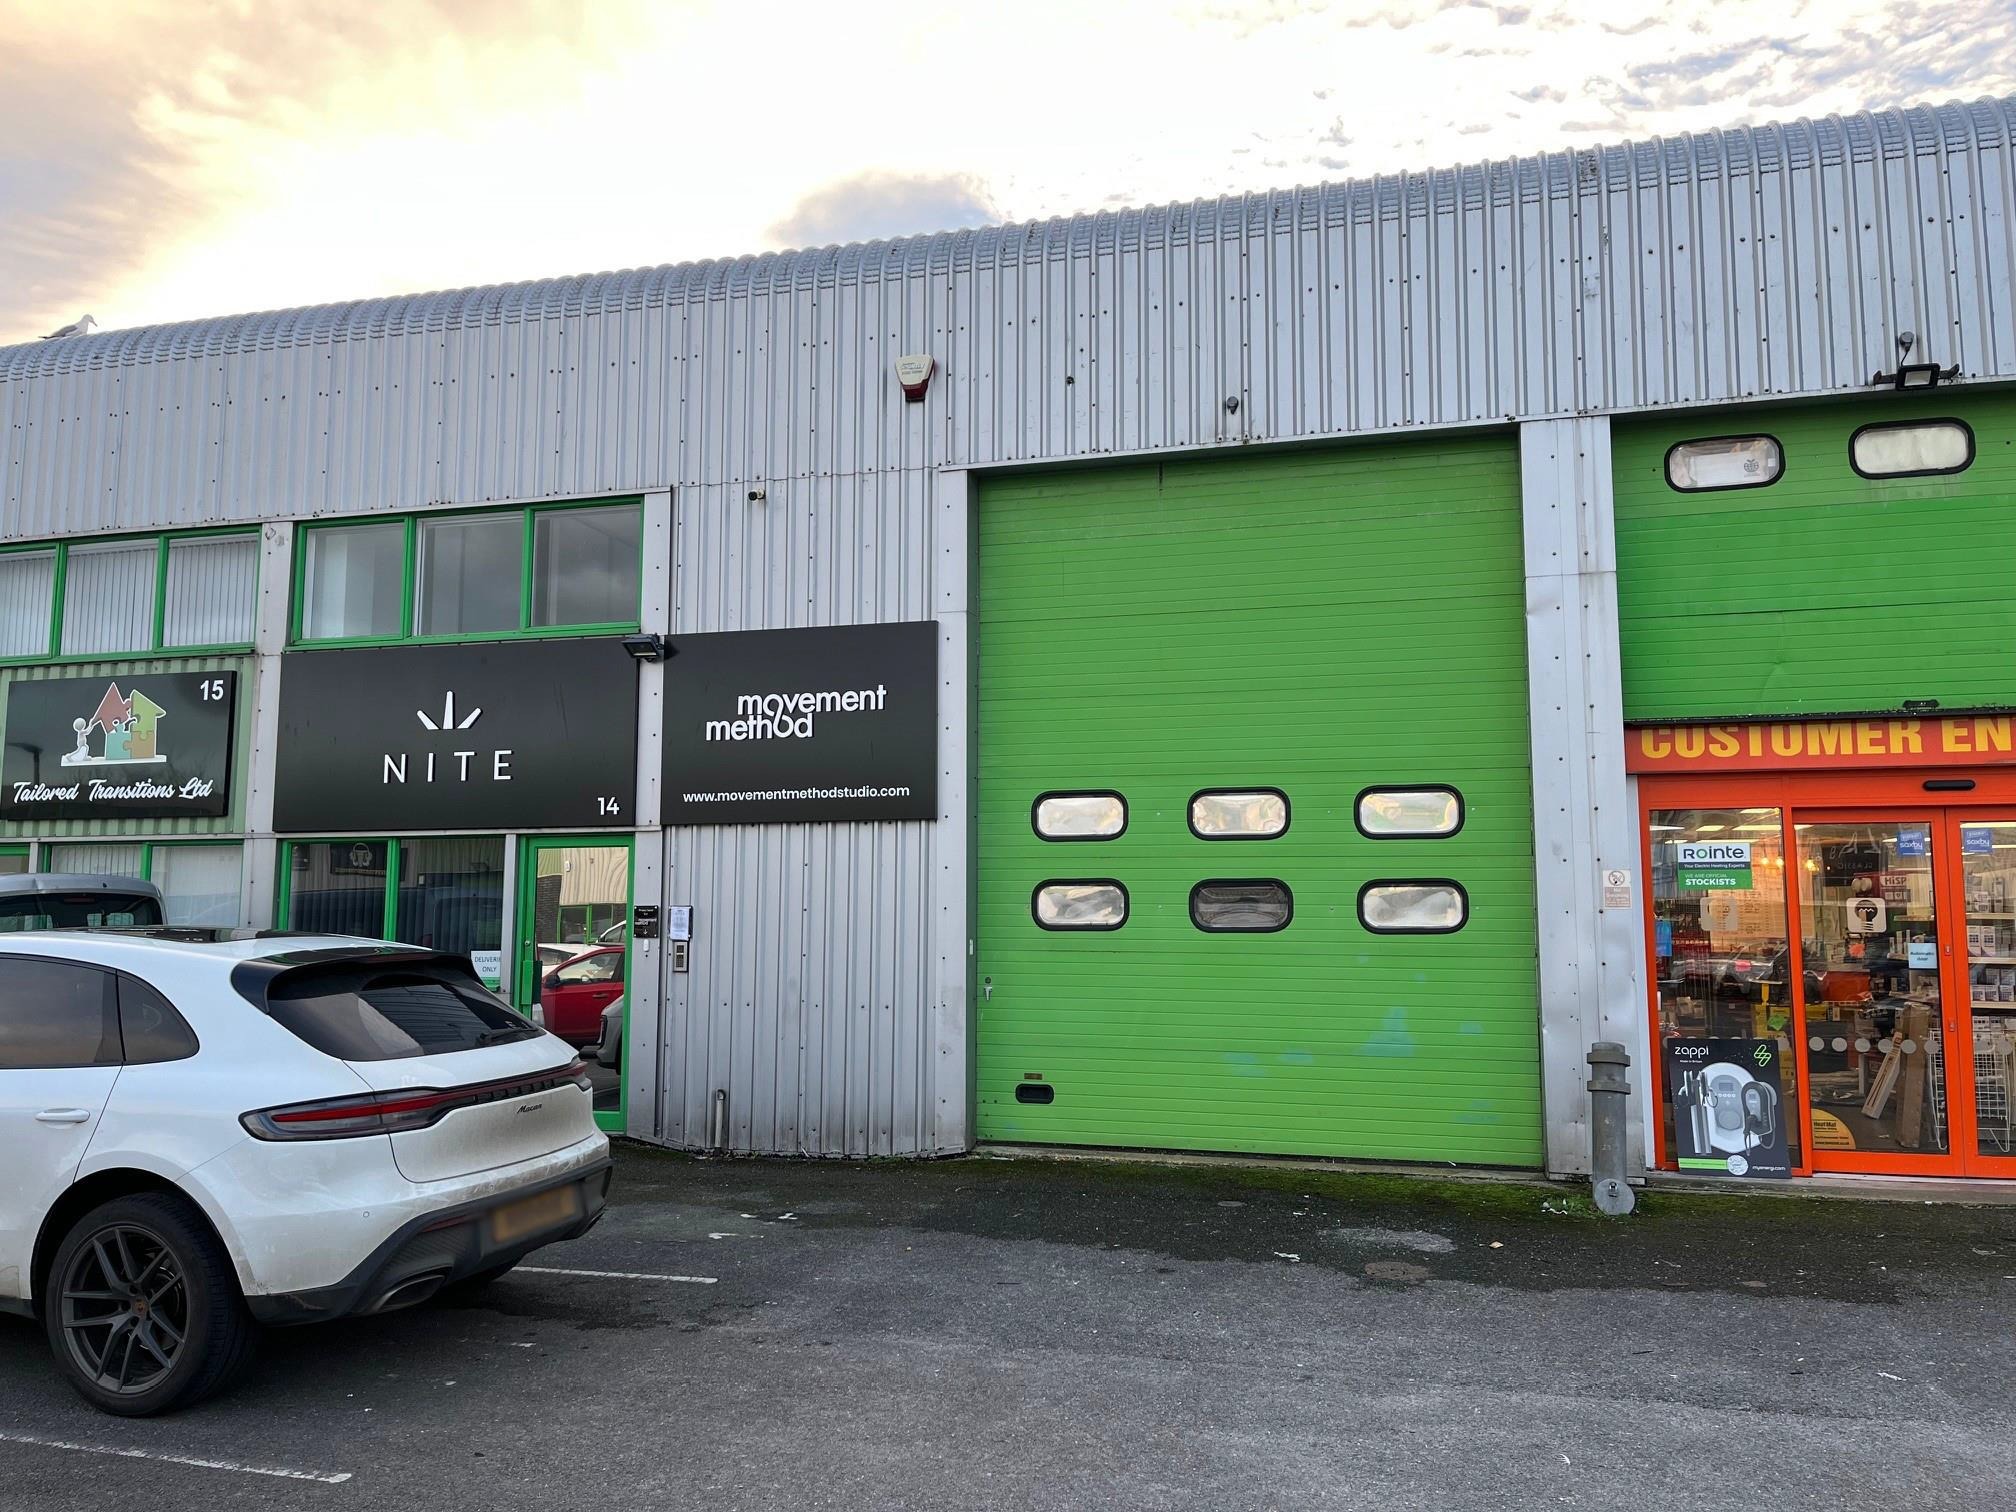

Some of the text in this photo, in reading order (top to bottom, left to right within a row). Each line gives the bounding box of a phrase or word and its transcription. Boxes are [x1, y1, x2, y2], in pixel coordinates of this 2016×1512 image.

[200, 679, 224, 701] 15
[736, 684, 888, 717] movement
[705, 713, 813, 741] method
[1641, 717, 2016, 759] CUSTOMER EN
[383, 749, 513, 784] NITE
[13, 776, 214, 804] Tailored Transitions Ltd
[682, 784, 910, 803] www.movementmethodstudio.com
[597, 796, 620, 816] 14
[1683, 845, 1744, 859] Rointe
[1900, 840, 1923, 850] saxby
[1685, 878, 1736, 886] STOCKISTS
[1674, 1045, 1709, 1059] zappi
